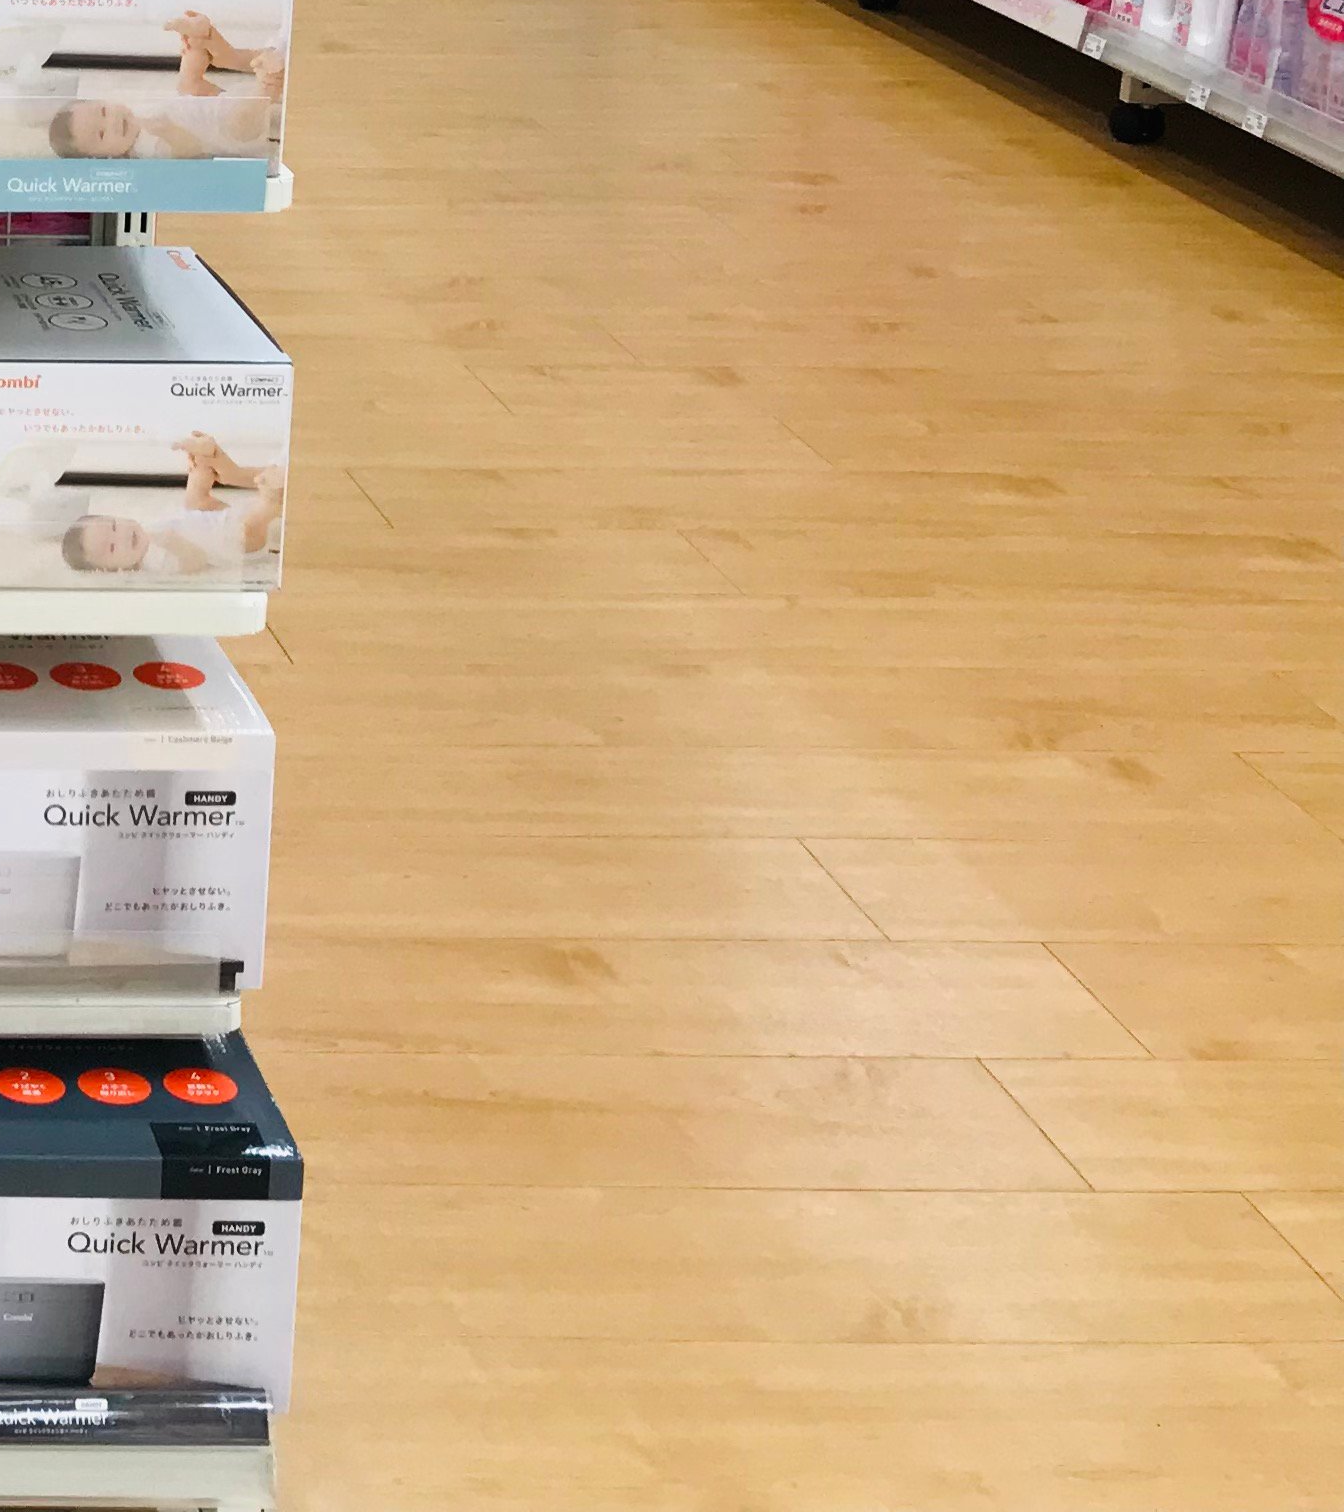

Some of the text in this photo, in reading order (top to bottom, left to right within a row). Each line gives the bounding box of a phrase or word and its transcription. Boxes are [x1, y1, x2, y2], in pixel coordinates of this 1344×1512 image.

[170, 383, 284, 397] Quick Warmer
[193, 795, 228, 803] HANDY
[44, 804, 235, 827] Quick Warmer
